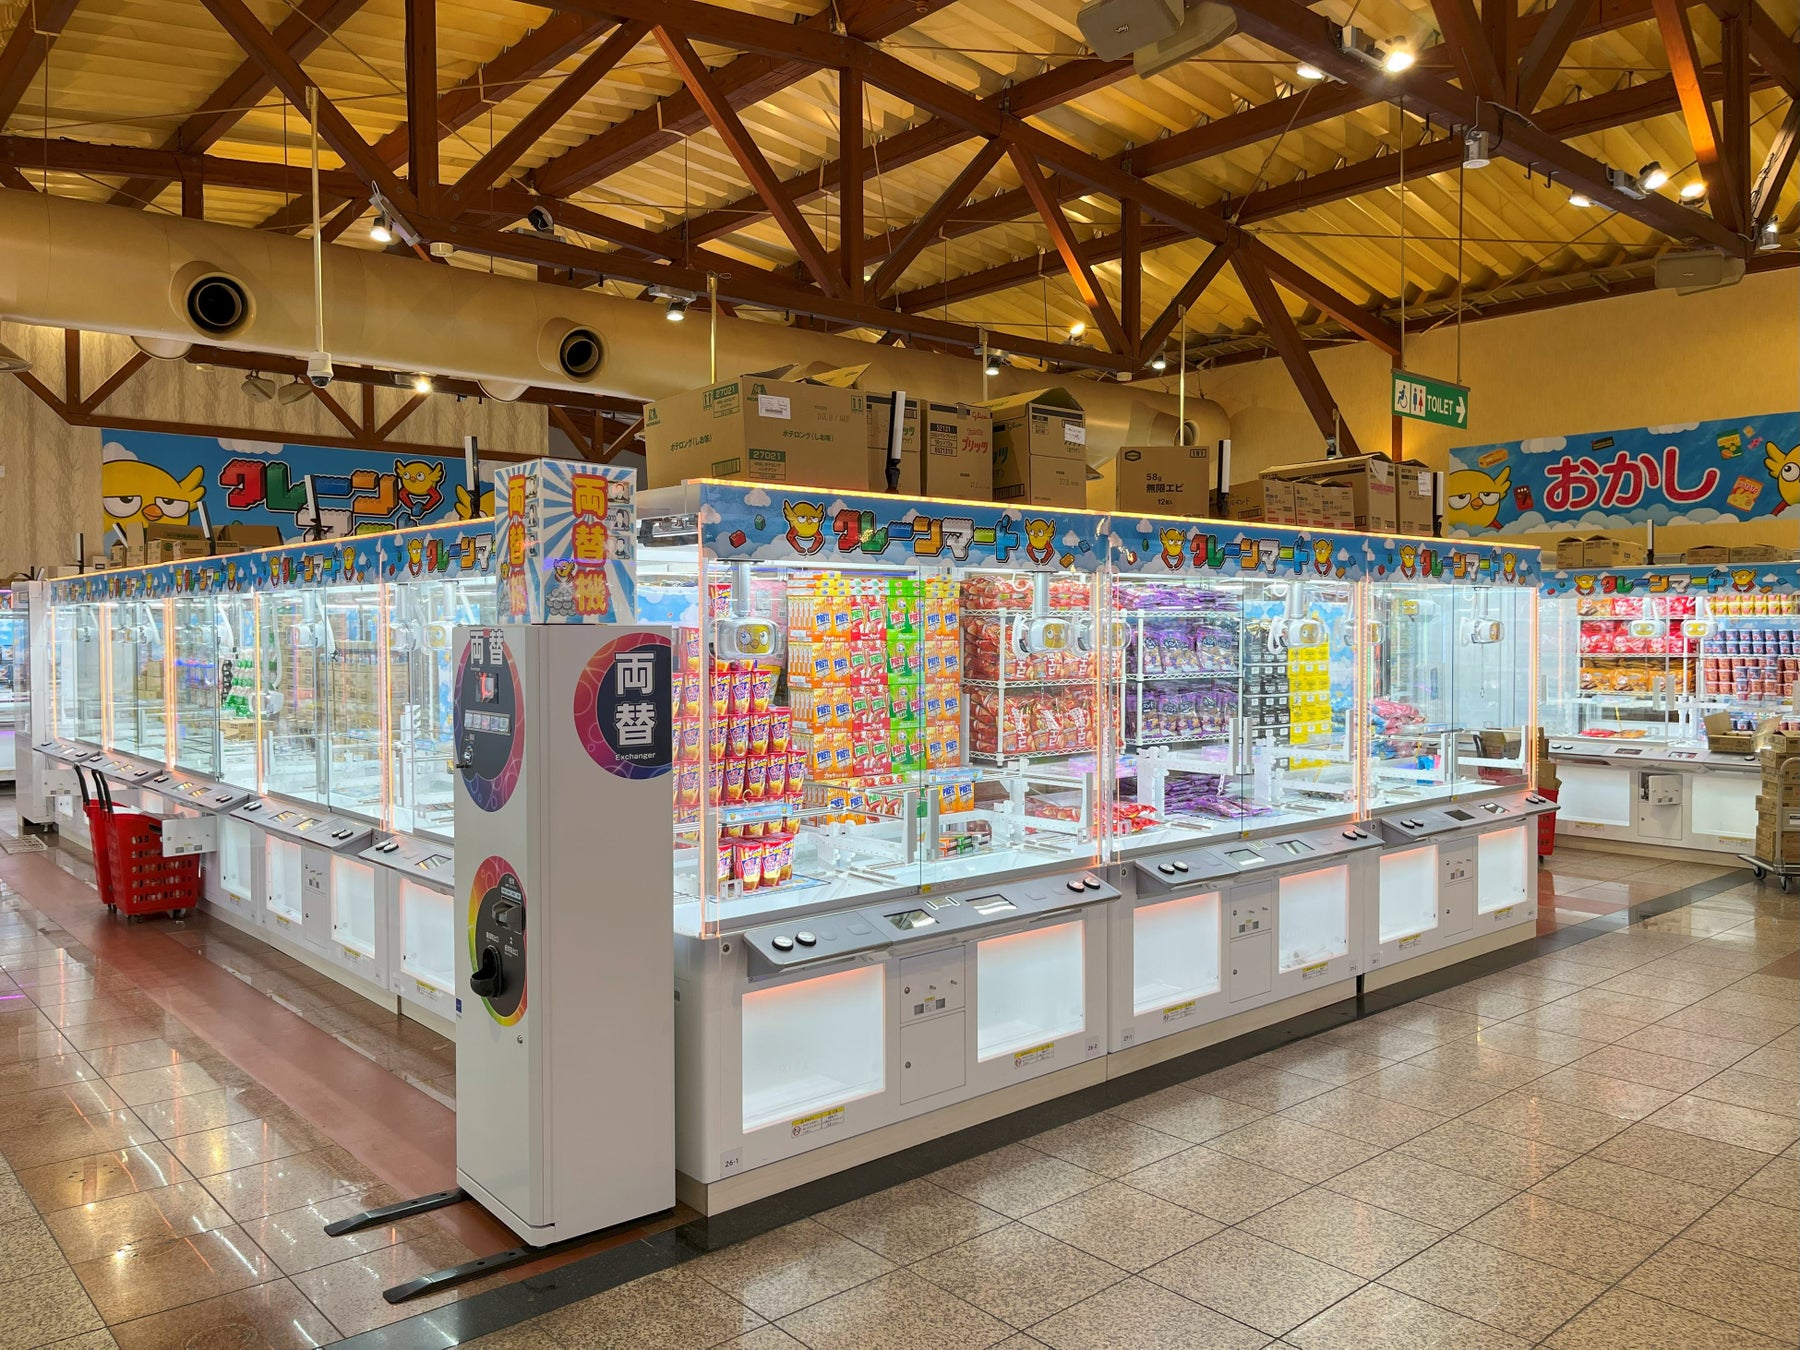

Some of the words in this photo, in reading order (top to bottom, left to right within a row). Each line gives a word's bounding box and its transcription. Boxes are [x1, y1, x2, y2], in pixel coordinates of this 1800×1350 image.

[1426, 395, 1454, 415] TOILET
[753, 450, 780, 460] 27021
[219, 458, 399, 513] クレーン
[1146, 473, 1162, 482] 58g
[1146, 483, 1184, 493] 無限エビ
[1544, 446, 1720, 511] おかし
[425, 534, 496, 573] クレーンマ
[508, 473, 528, 616] 両替機
[571, 473, 611, 616] 両替機
[832, 509, 1020, 563] クレーンマート
[1190, 534, 1309, 575] クレーンマート
[282, 546, 341, 584] クレーンマート
[1419, 548, 1500, 581] クレーンマート
[1601, 569, 1727, 593] クレーンマート
[470, 629, 504, 665] 両替
[614, 652, 656, 746] 両替
[615, 752, 656, 761] Exchanger
[725, 1157, 739, 1168] 26-1
